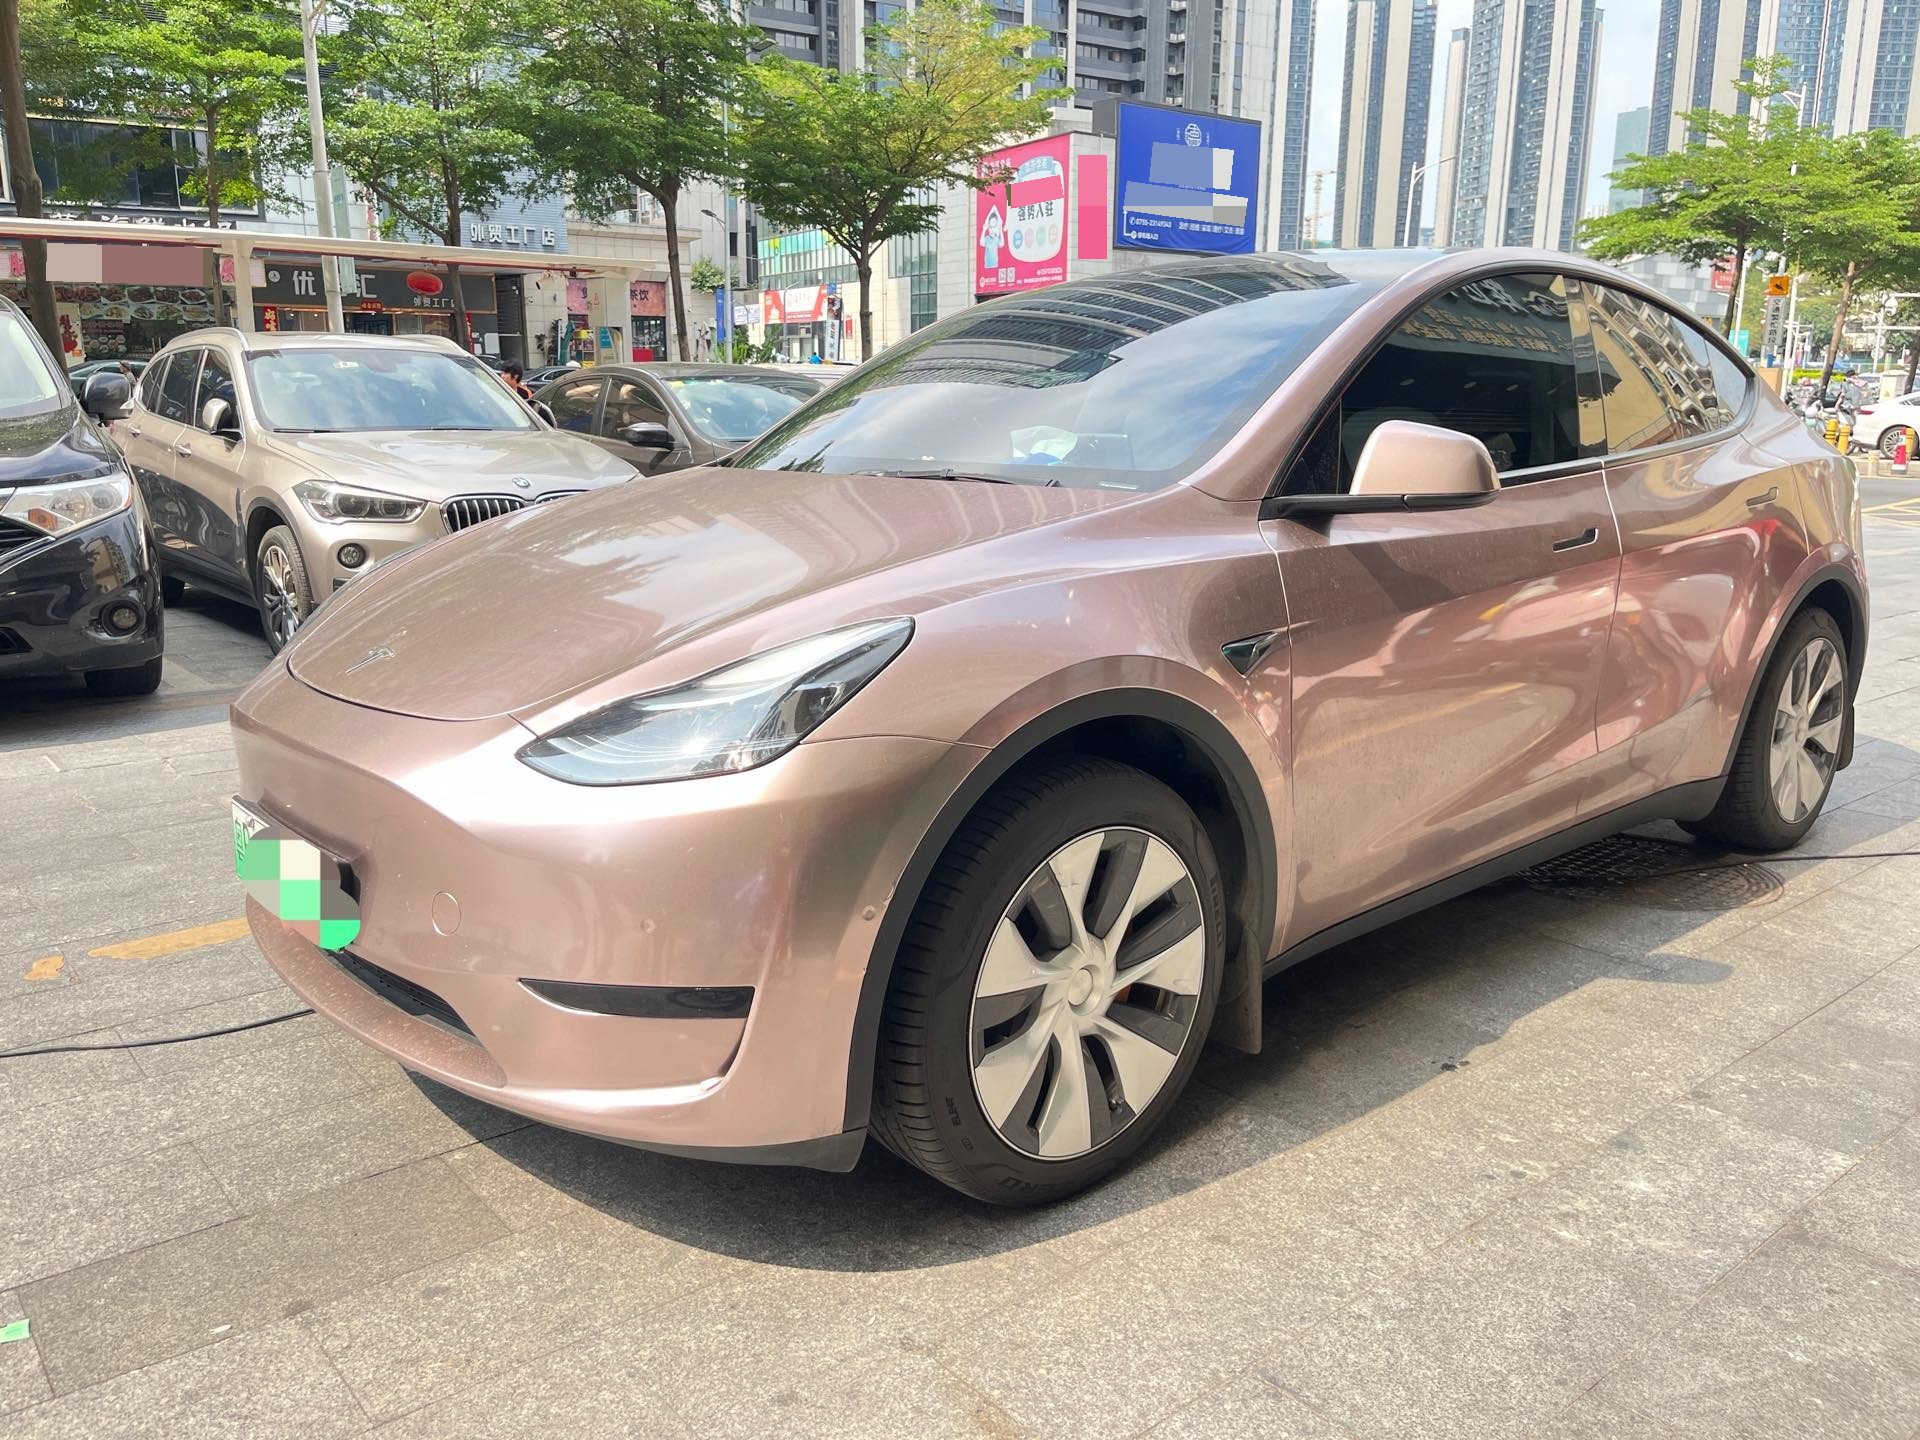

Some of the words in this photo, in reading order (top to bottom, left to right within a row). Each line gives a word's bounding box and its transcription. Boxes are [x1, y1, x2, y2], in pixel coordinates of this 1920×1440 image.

[470, 223, 555, 247] 外贸工厂店
